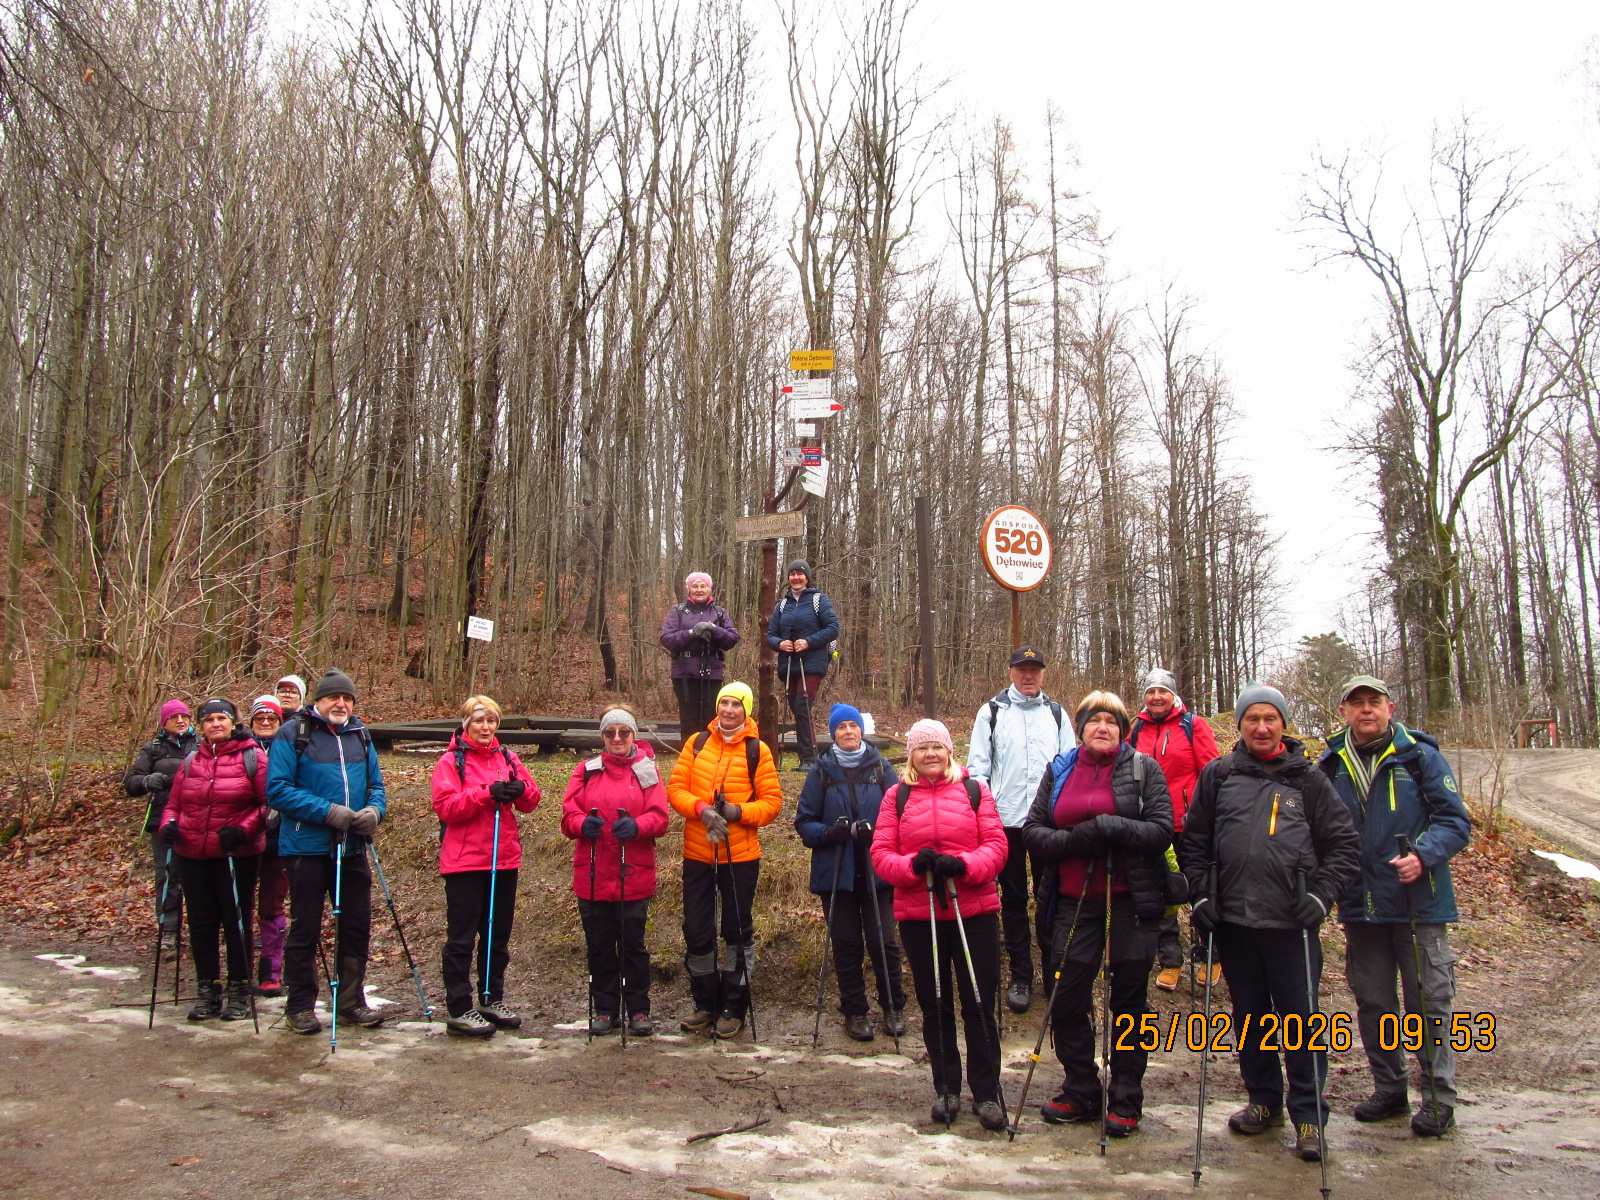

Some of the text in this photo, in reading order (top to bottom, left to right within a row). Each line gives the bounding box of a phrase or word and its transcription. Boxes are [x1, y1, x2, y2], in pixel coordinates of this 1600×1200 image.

[809, 354, 832, 362] Dębowiec
[994, 519, 1040, 531] GOSPODA
[994, 527, 1043, 556] 520
[996, 555, 1044, 569] Dębowiec
